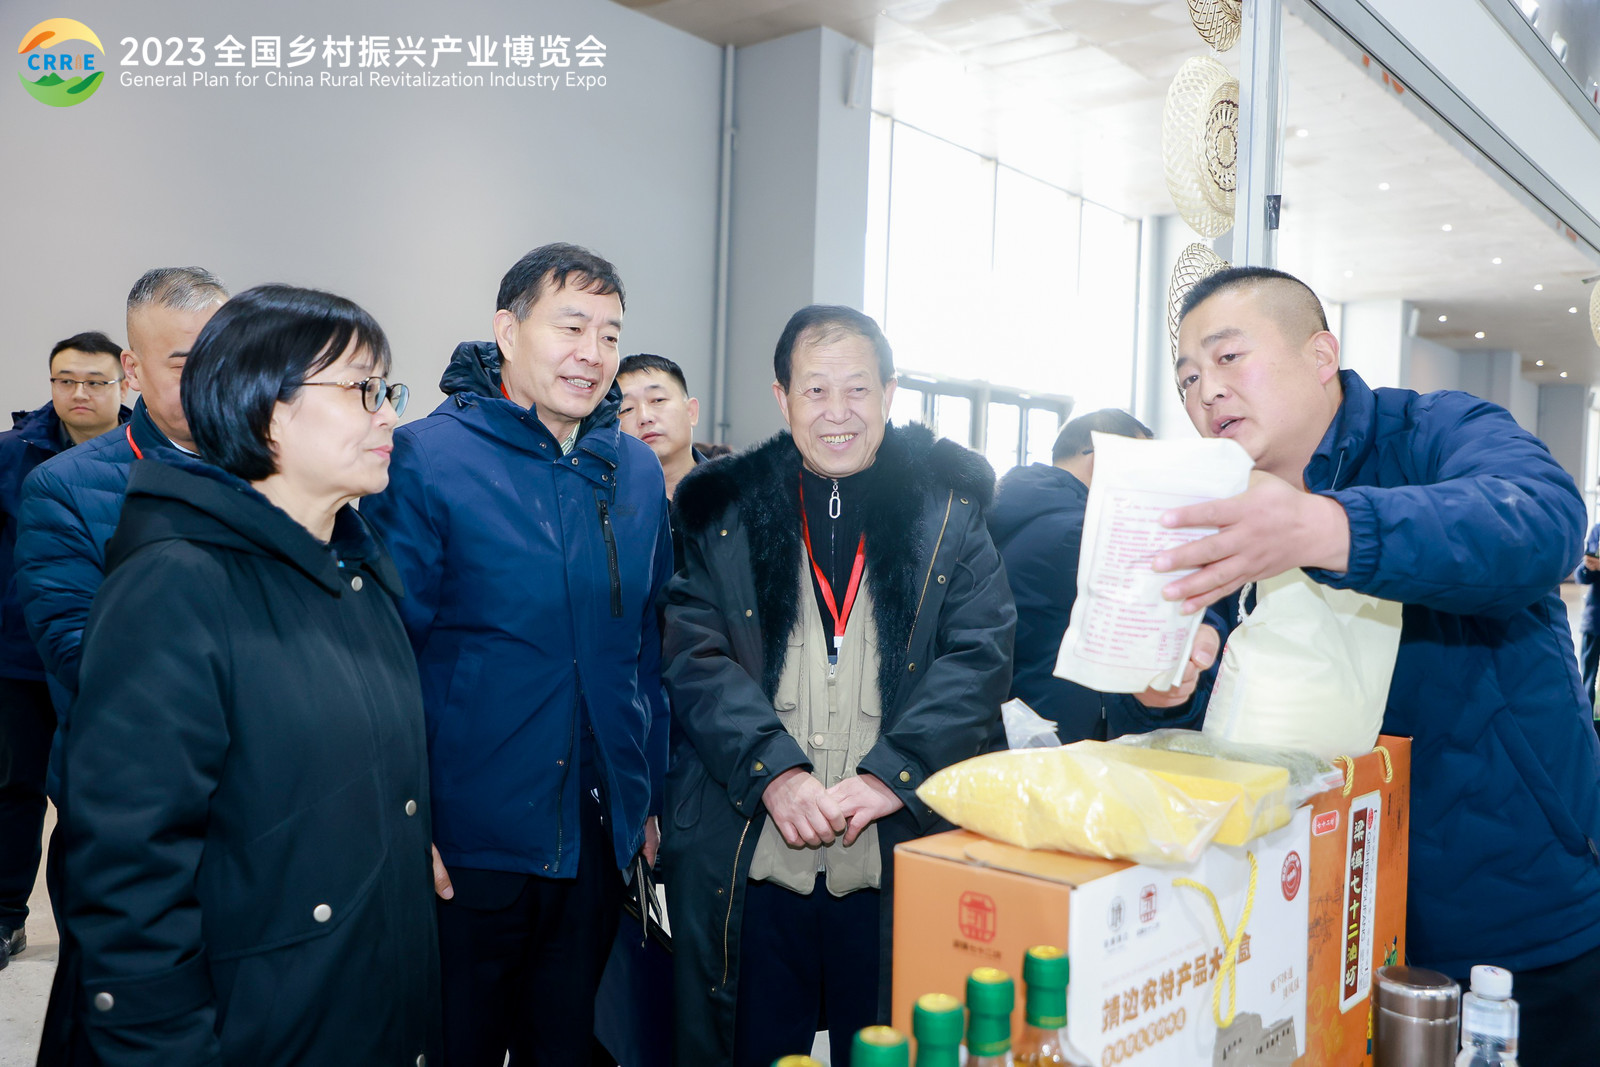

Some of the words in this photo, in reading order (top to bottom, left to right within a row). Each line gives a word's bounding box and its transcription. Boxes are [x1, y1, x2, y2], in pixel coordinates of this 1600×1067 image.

[1102, 932, 1251, 1033] 靖边农特产品大盒
